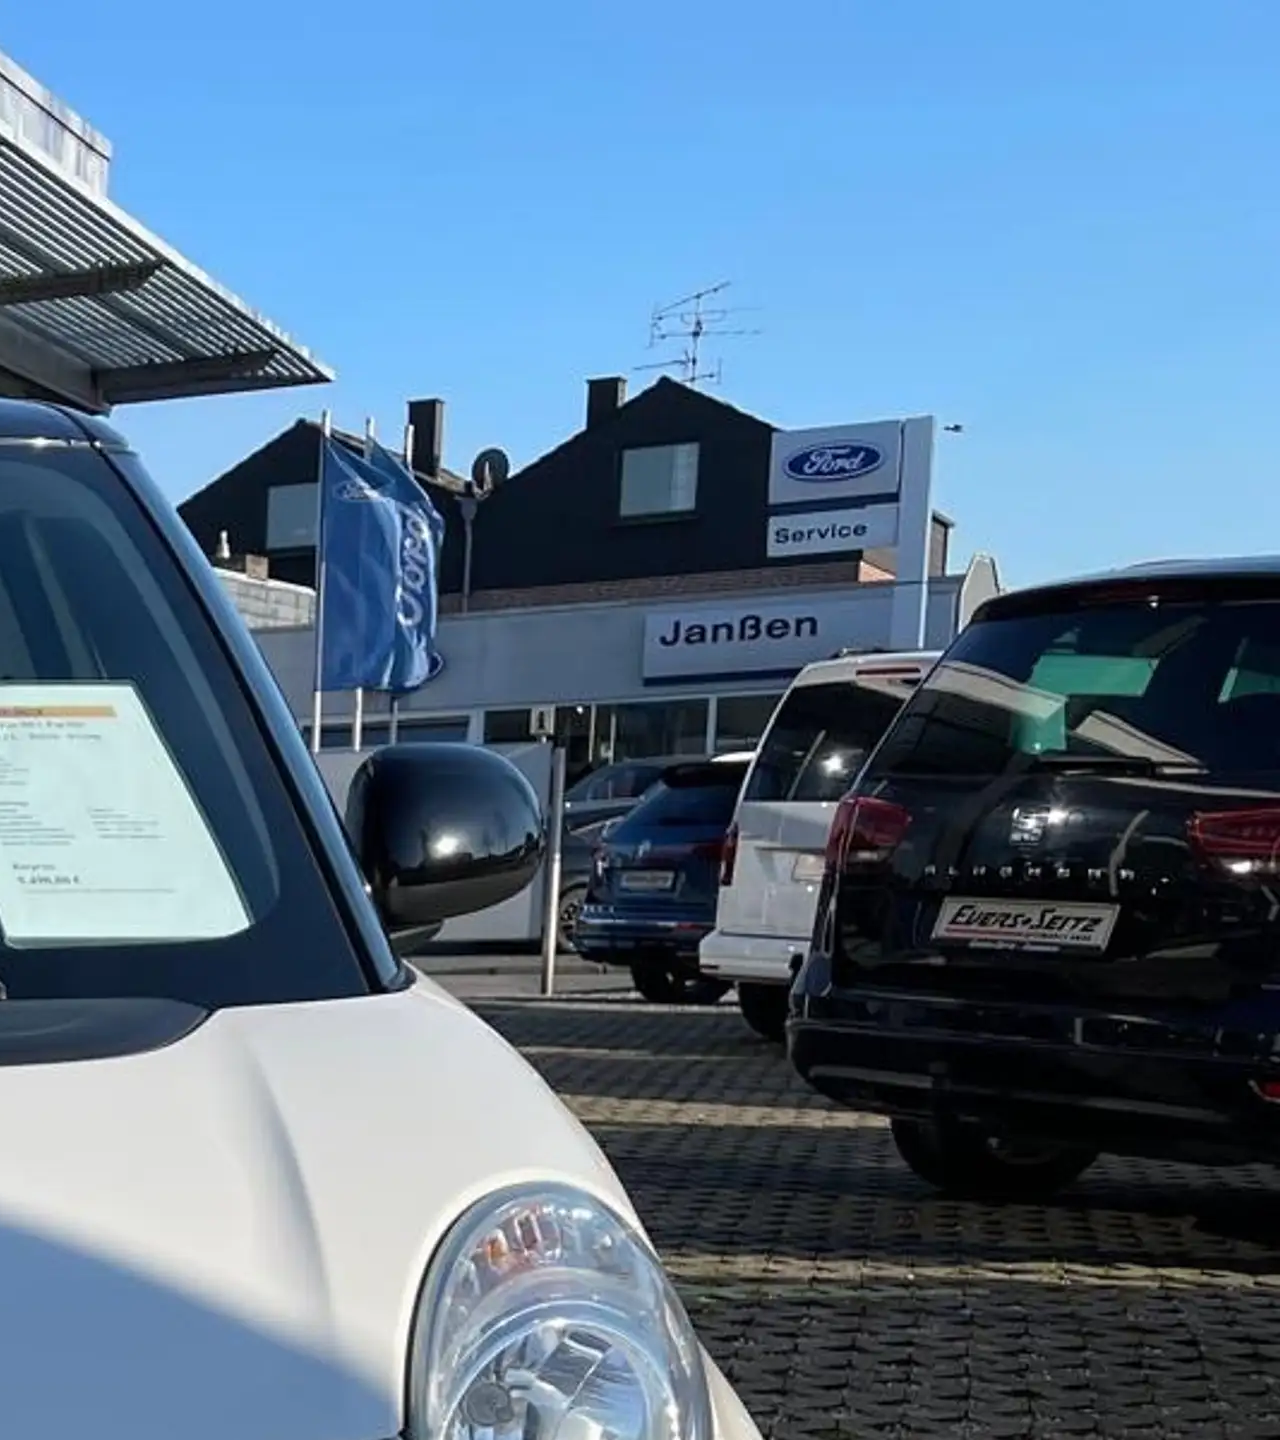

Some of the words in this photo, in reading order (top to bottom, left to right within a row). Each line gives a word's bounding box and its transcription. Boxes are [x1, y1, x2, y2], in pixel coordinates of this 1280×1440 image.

[803, 448, 866, 474] Ford
[775, 523, 868, 544] Service
[659, 614, 818, 647] Janßen
